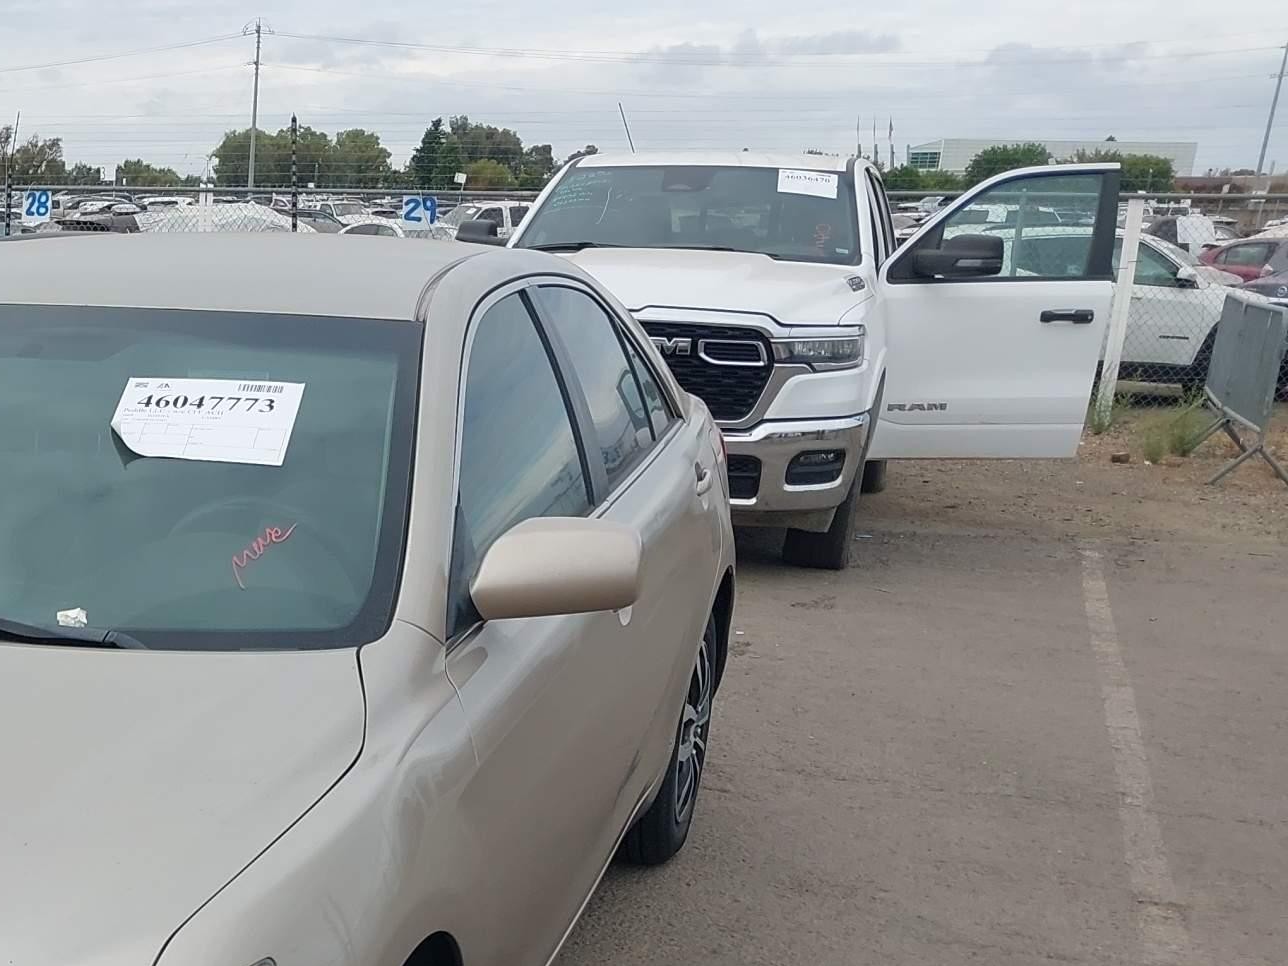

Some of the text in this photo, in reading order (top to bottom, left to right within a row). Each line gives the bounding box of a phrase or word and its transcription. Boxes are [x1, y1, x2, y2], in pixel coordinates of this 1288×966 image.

[25, 191, 49, 216] 28
[404, 196, 437, 224] 29
[137, 394, 275, 413] 46047773
[887, 403, 948, 412] RAM
